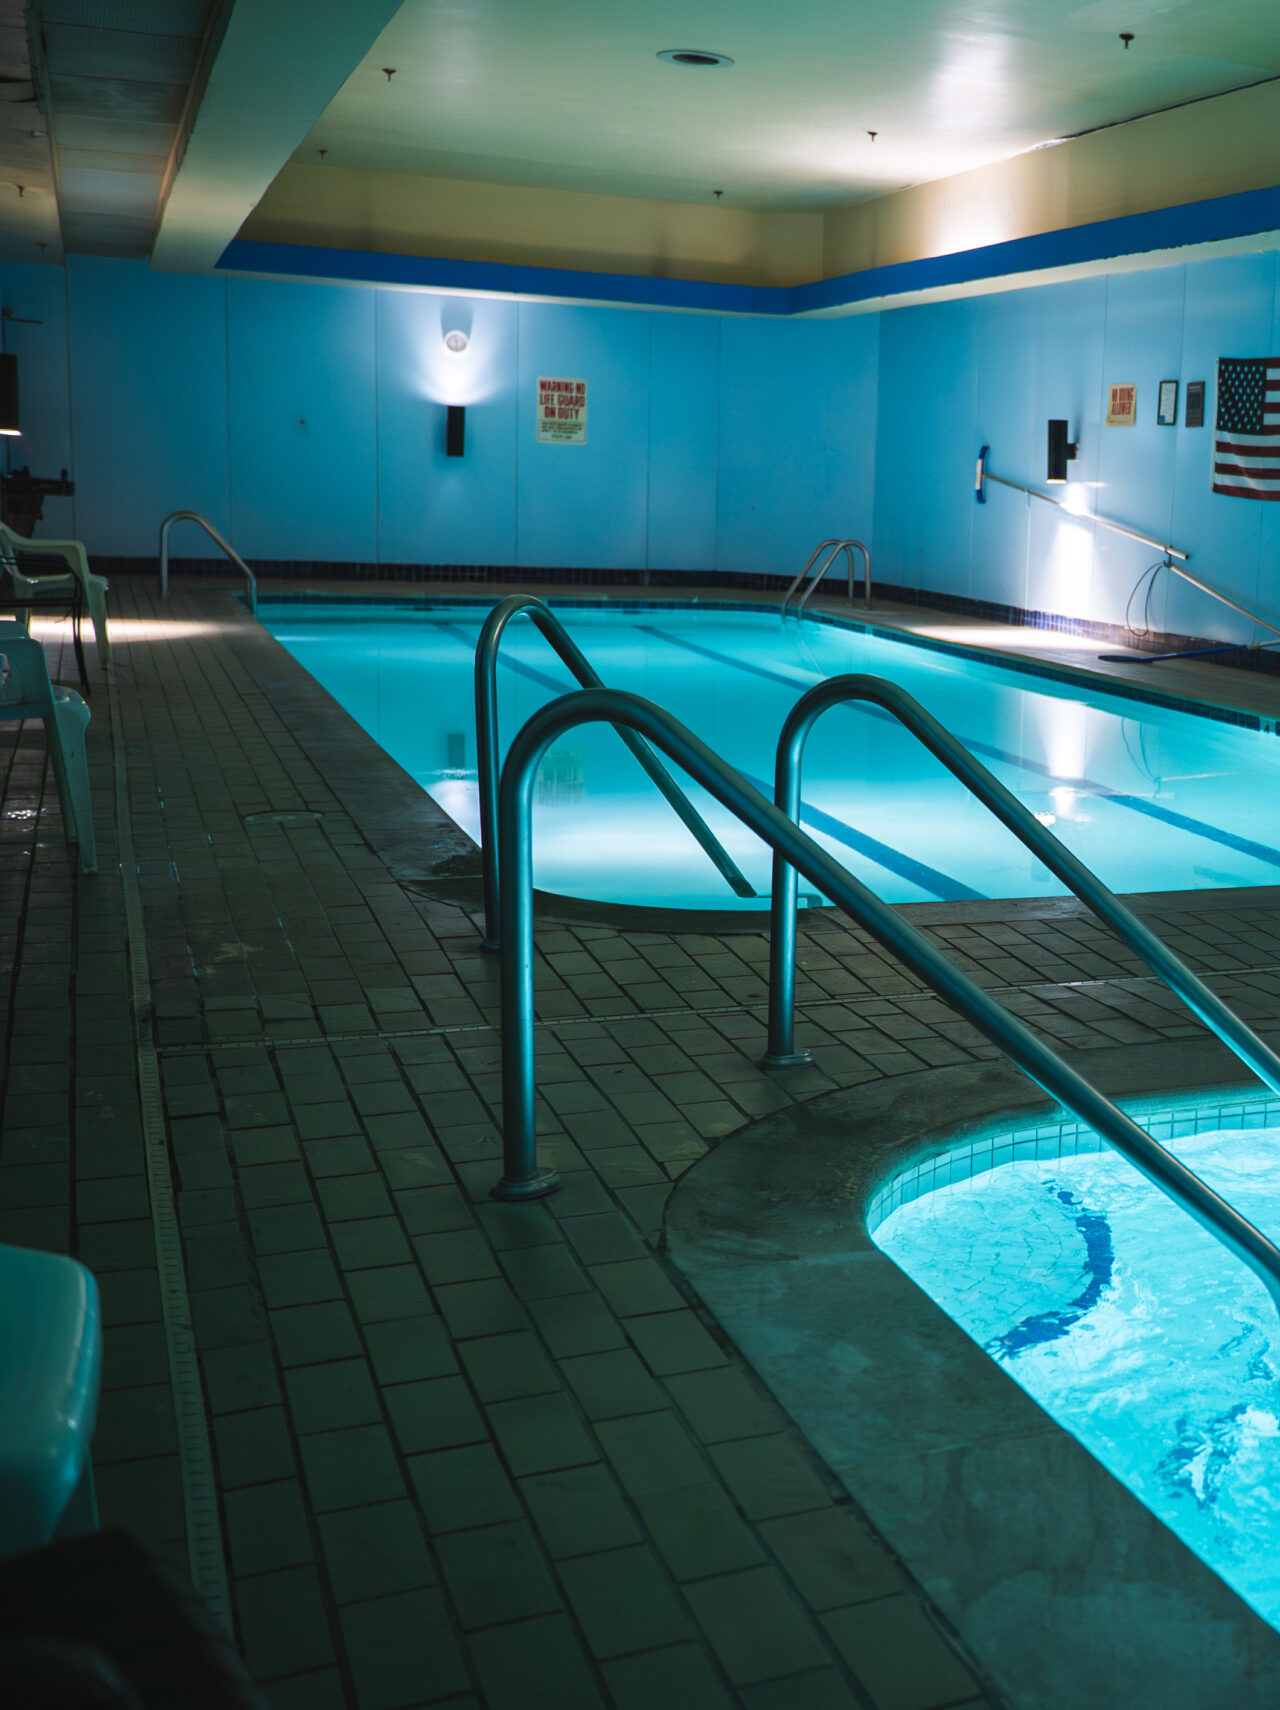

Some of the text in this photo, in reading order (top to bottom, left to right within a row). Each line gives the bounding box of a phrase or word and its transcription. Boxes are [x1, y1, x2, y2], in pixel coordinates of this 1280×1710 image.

[539, 380, 585, 395] WARNING NO
[539, 392, 585, 407] LIFE GUARD
[544, 406, 580, 420] ON DUTY
